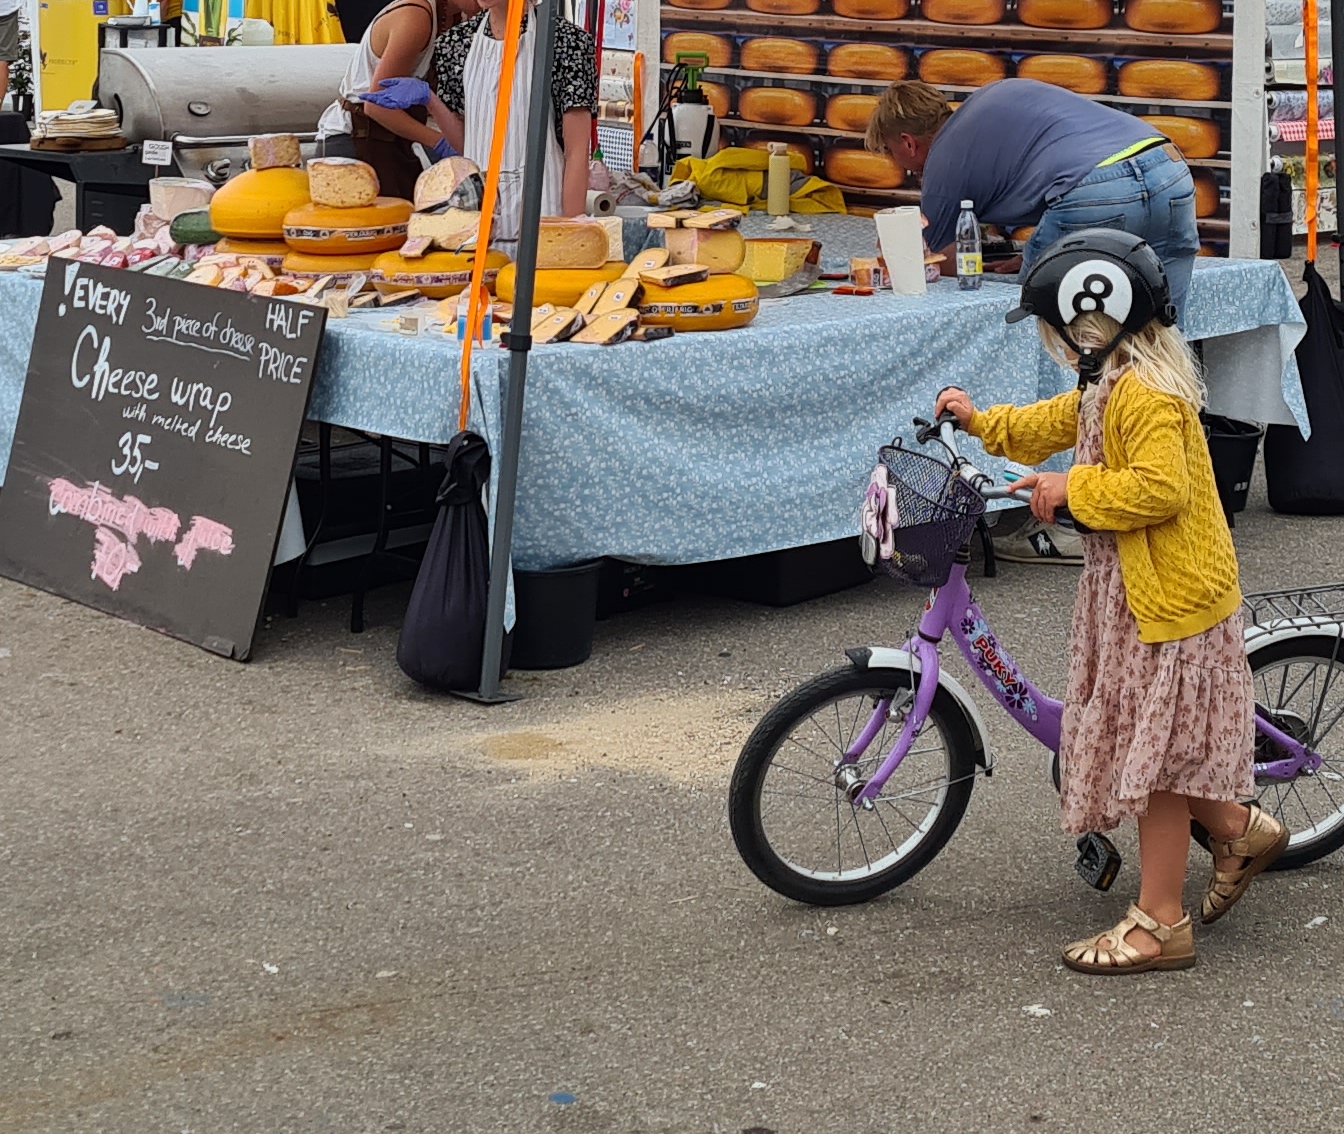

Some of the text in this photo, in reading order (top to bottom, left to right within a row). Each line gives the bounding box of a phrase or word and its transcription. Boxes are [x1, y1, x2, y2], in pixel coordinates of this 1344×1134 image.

[1072, 273, 1114, 314] 8
[142, 298, 168, 334] 3rd
[172, 315, 201, 340] piece
[202, 311, 222, 338] of
[220, 323, 256, 355] cheese
[265, 303, 314, 339] HALF
[71, 324, 233, 428] Cheese wrap
[258, 342, 308, 384] PRICE
[122, 401, 252, 456] with melted cheese
[111, 431, 160, 484] 35,-
[974, 635, 1018, 686] PUKY
